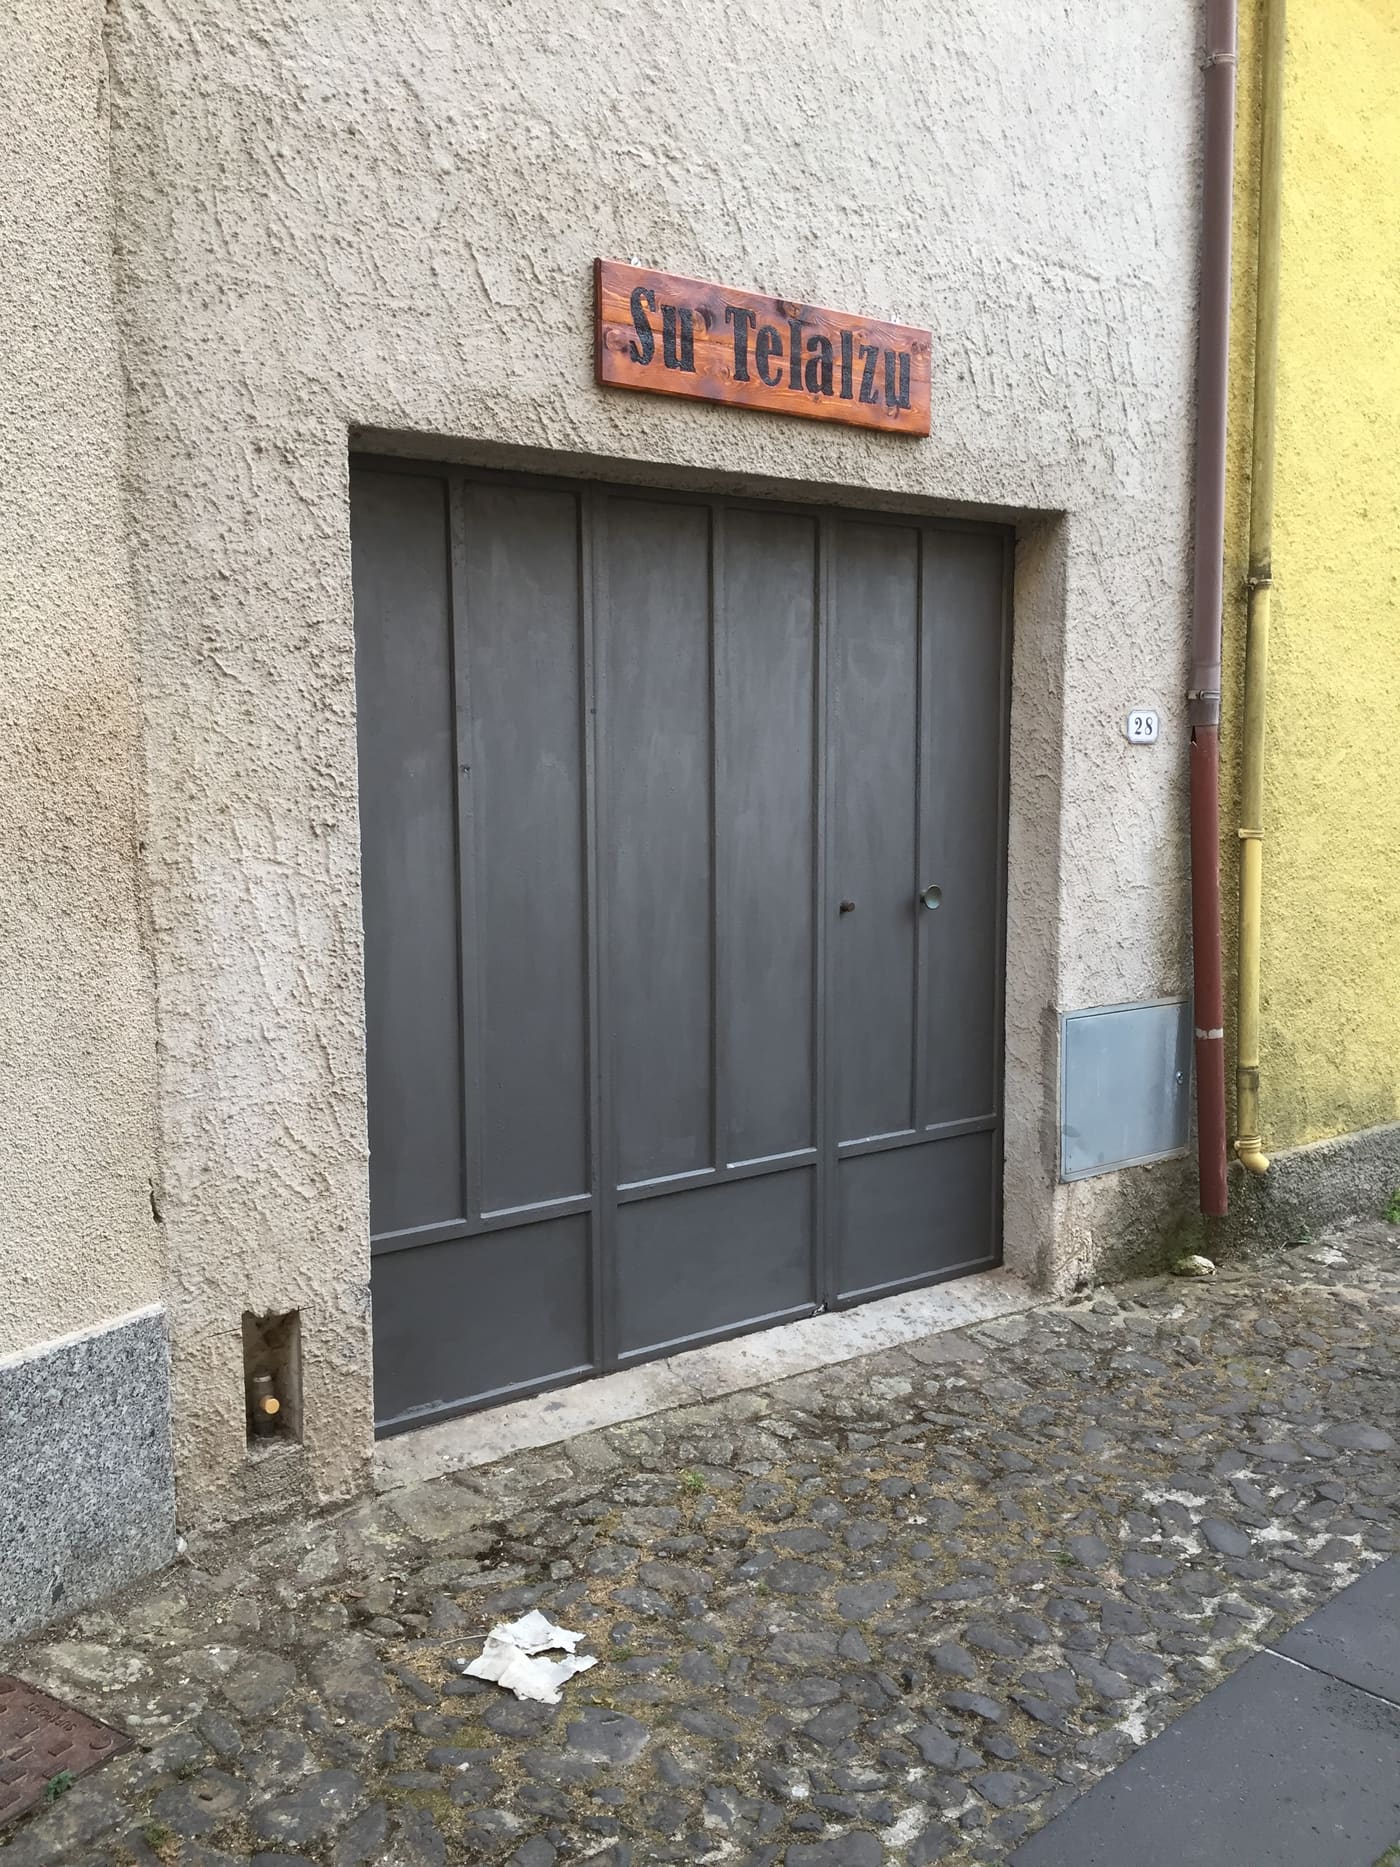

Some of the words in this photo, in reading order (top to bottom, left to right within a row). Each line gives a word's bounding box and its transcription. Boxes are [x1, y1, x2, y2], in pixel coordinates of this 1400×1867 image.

[630, 286, 696, 373] Su
[725, 305, 911, 410] Telalzu
[1134, 716, 1153, 736] 28
